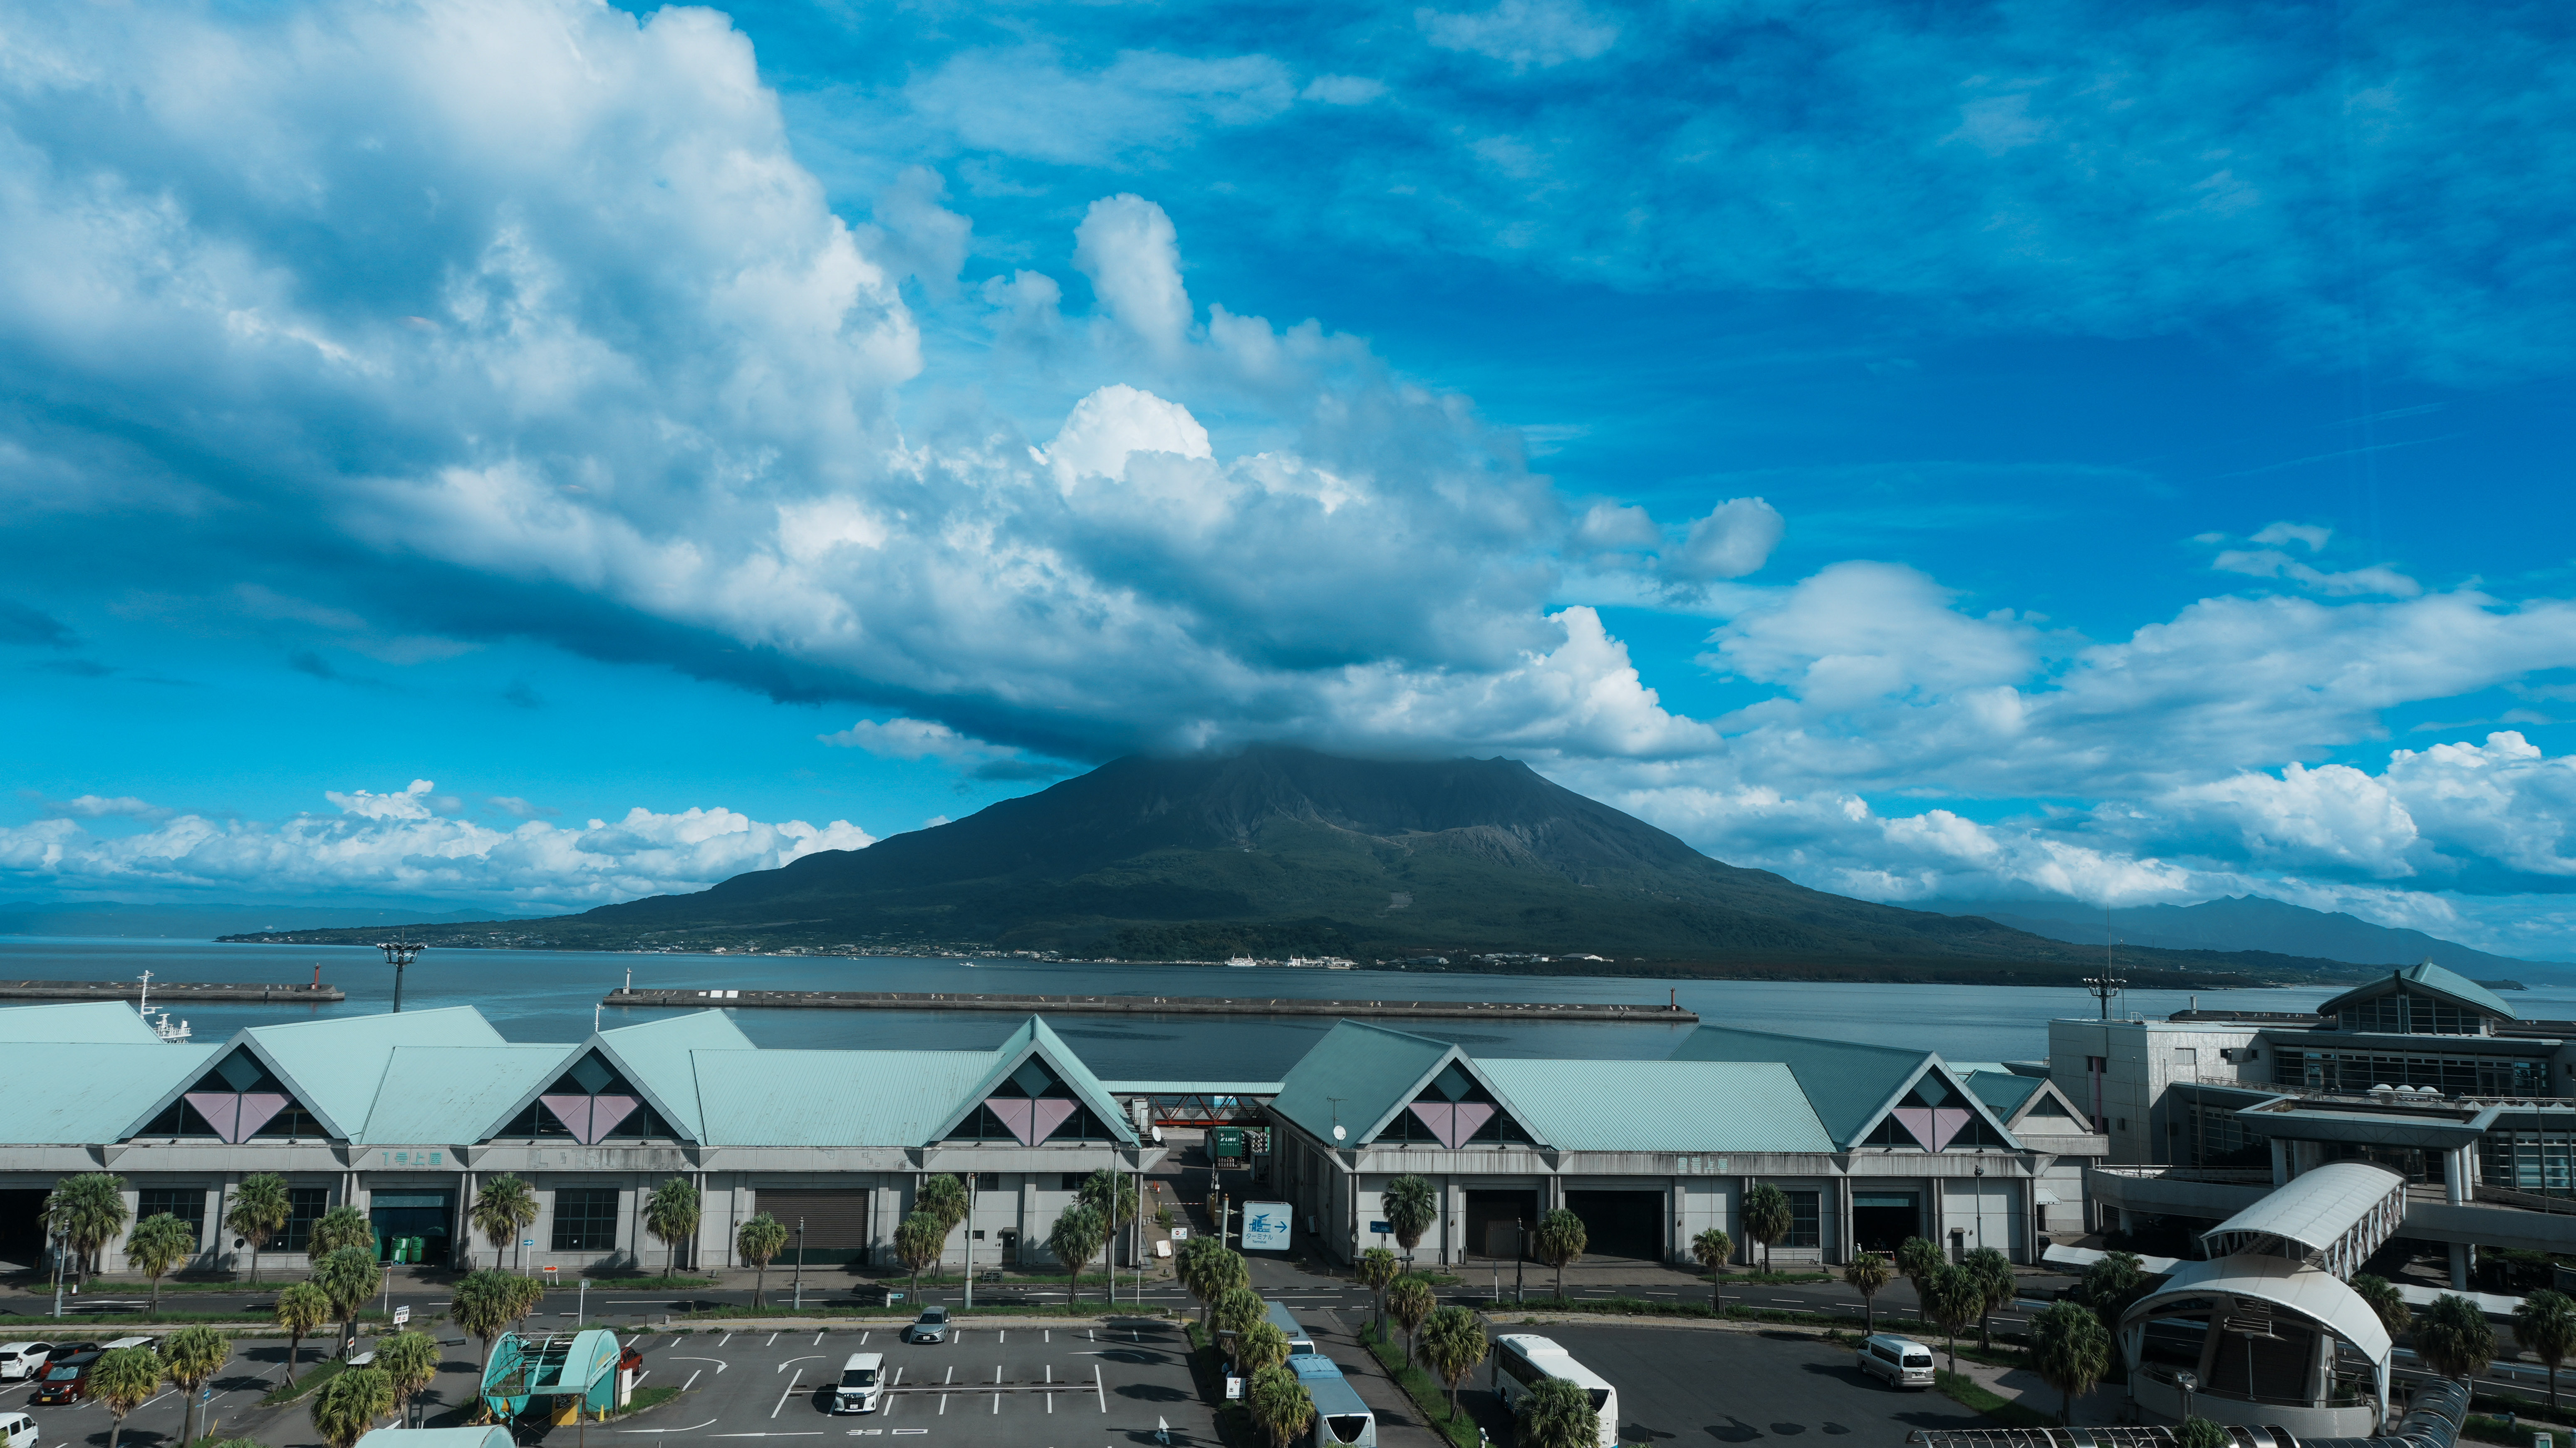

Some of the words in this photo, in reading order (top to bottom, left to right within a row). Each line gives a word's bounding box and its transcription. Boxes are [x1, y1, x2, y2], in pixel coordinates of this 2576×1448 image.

[382, 1152, 442, 1166] 1号上屋
[1678, 1158, 1728, 1170] 2号上屋
